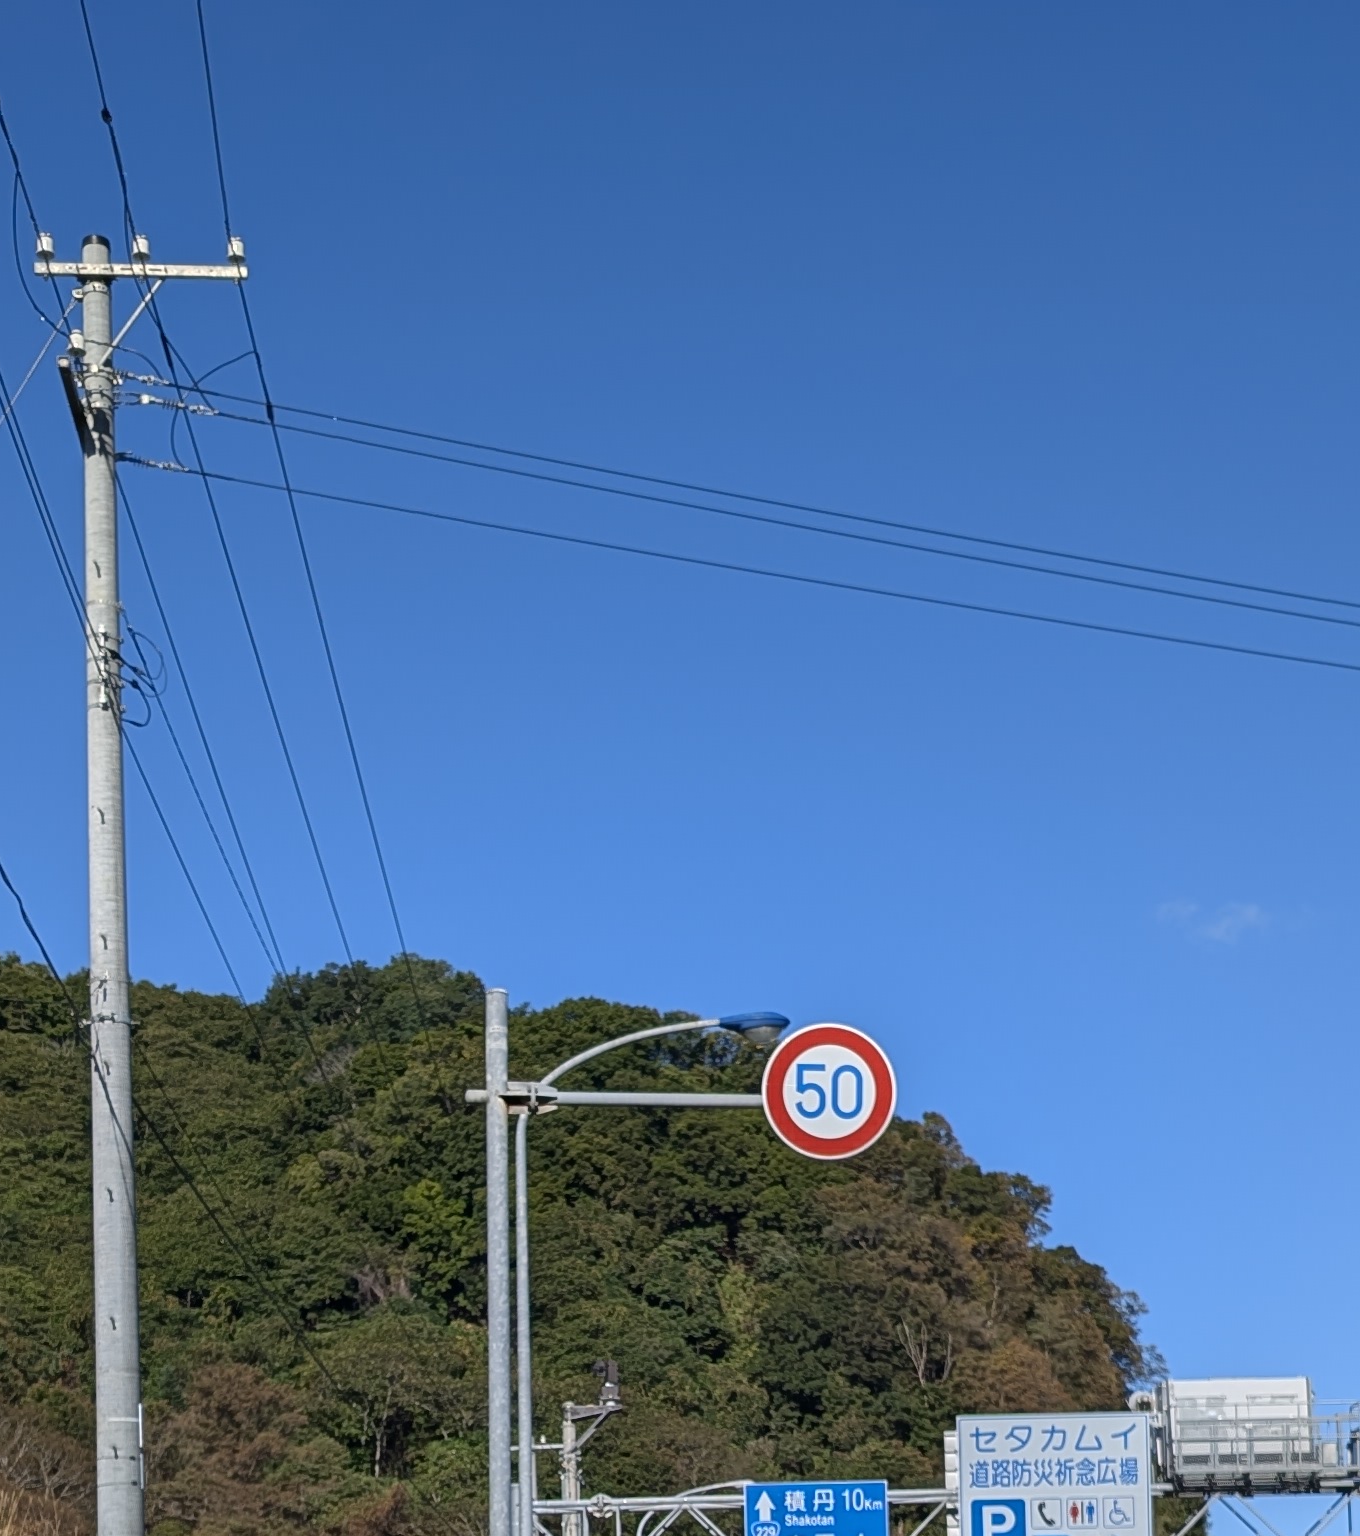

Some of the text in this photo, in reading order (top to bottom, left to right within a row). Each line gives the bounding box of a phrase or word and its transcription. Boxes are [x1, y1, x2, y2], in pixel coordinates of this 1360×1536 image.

[795, 1063, 863, 1120] 50
[969, 1423, 1137, 1453] セタカムイ
[969, 1456, 1138, 1489] 道路防災祈念広場
[784, 1488, 835, 1512] 積丹
[784, 1513, 835, 1527] Shakotan
